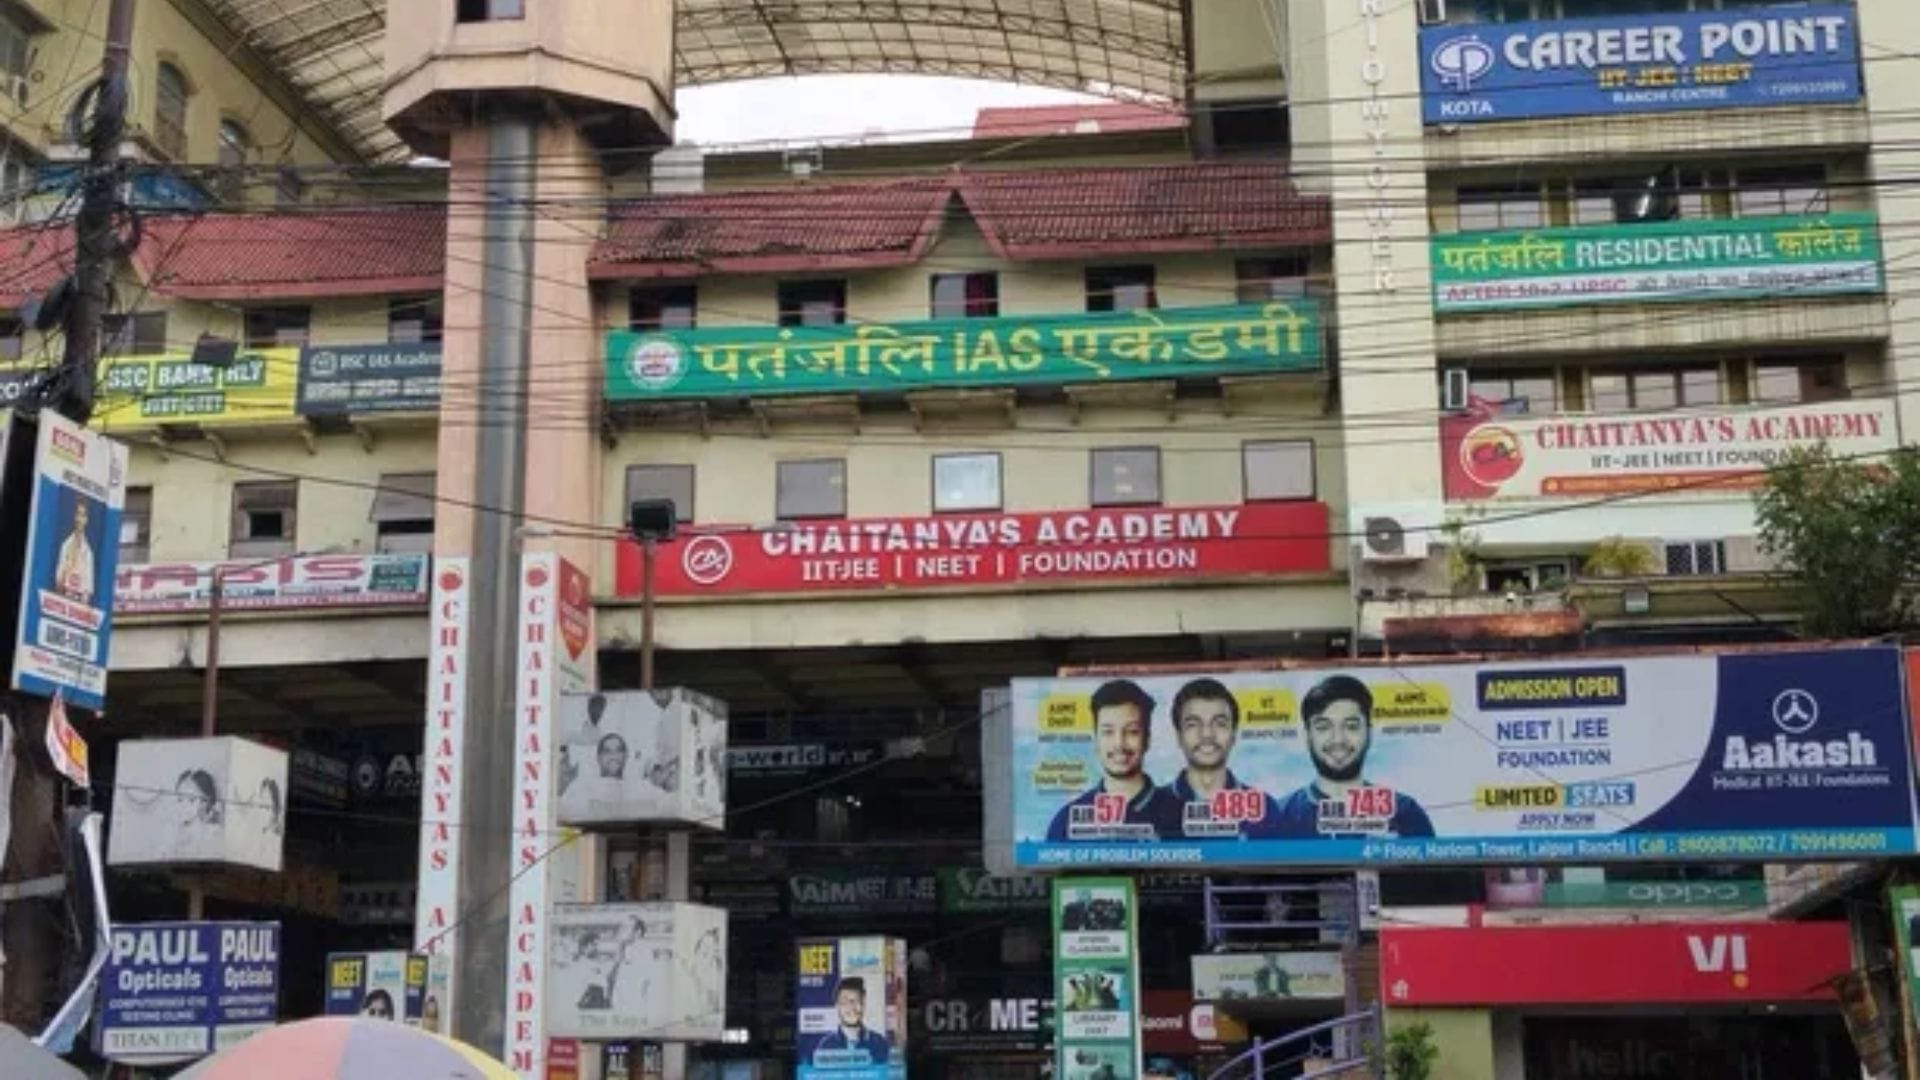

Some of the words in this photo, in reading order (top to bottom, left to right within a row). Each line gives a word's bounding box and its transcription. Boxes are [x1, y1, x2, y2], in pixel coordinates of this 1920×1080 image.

[1503, 26, 1687, 70] CAREER
[1700, 16, 1846, 59] POINT
[1440, 101, 1494, 116] KOTA
[1575, 231, 1773, 268] RESIDENTIAL
[692, 325, 942, 381] पतंजलि
[954, 328, 1042, 372] IAS
[1053, 303, 1311, 377] एकेडमी
[1536, 415, 1735, 449] CHAITANYA'S
[1746, 411, 1883, 441] ACADEMY
[1663, 451, 1704, 465] NEET
[761, 517, 1021, 556] CHAITANYA'S
[1037, 511, 1239, 545] ACADEMY
[916, 552, 981, 577] NEET
[1019, 548, 1197, 574] FOUNDATION
[1484, 677, 1570, 700] ADMISSION
[1575, 675, 1618, 697] OPEN
[1496, 719, 1552, 740] NEET
[1572, 718, 1609, 739] JEE
[1497, 749, 1612, 768] FOUNDATION
[1722, 731, 1877, 770] Aakash
[1212, 792, 1263, 820] 489
[1347, 789, 1394, 817] 743
[1485, 787, 1558, 806] LIMITED
[1572, 784, 1629, 804] SEATS
[1096, 795, 1126, 824] 57
[1520, 813, 1558, 826] APPLY
[1563, 812, 1596, 825] NOW
[1627, 883, 1740, 904] oppo
[111, 930, 209, 966] PAUL
[221, 928, 277, 963] PAUL
[118, 967, 202, 995] Opticals
[224, 965, 273, 990] Opticals
[111, 1032, 161, 1047] TITAN
